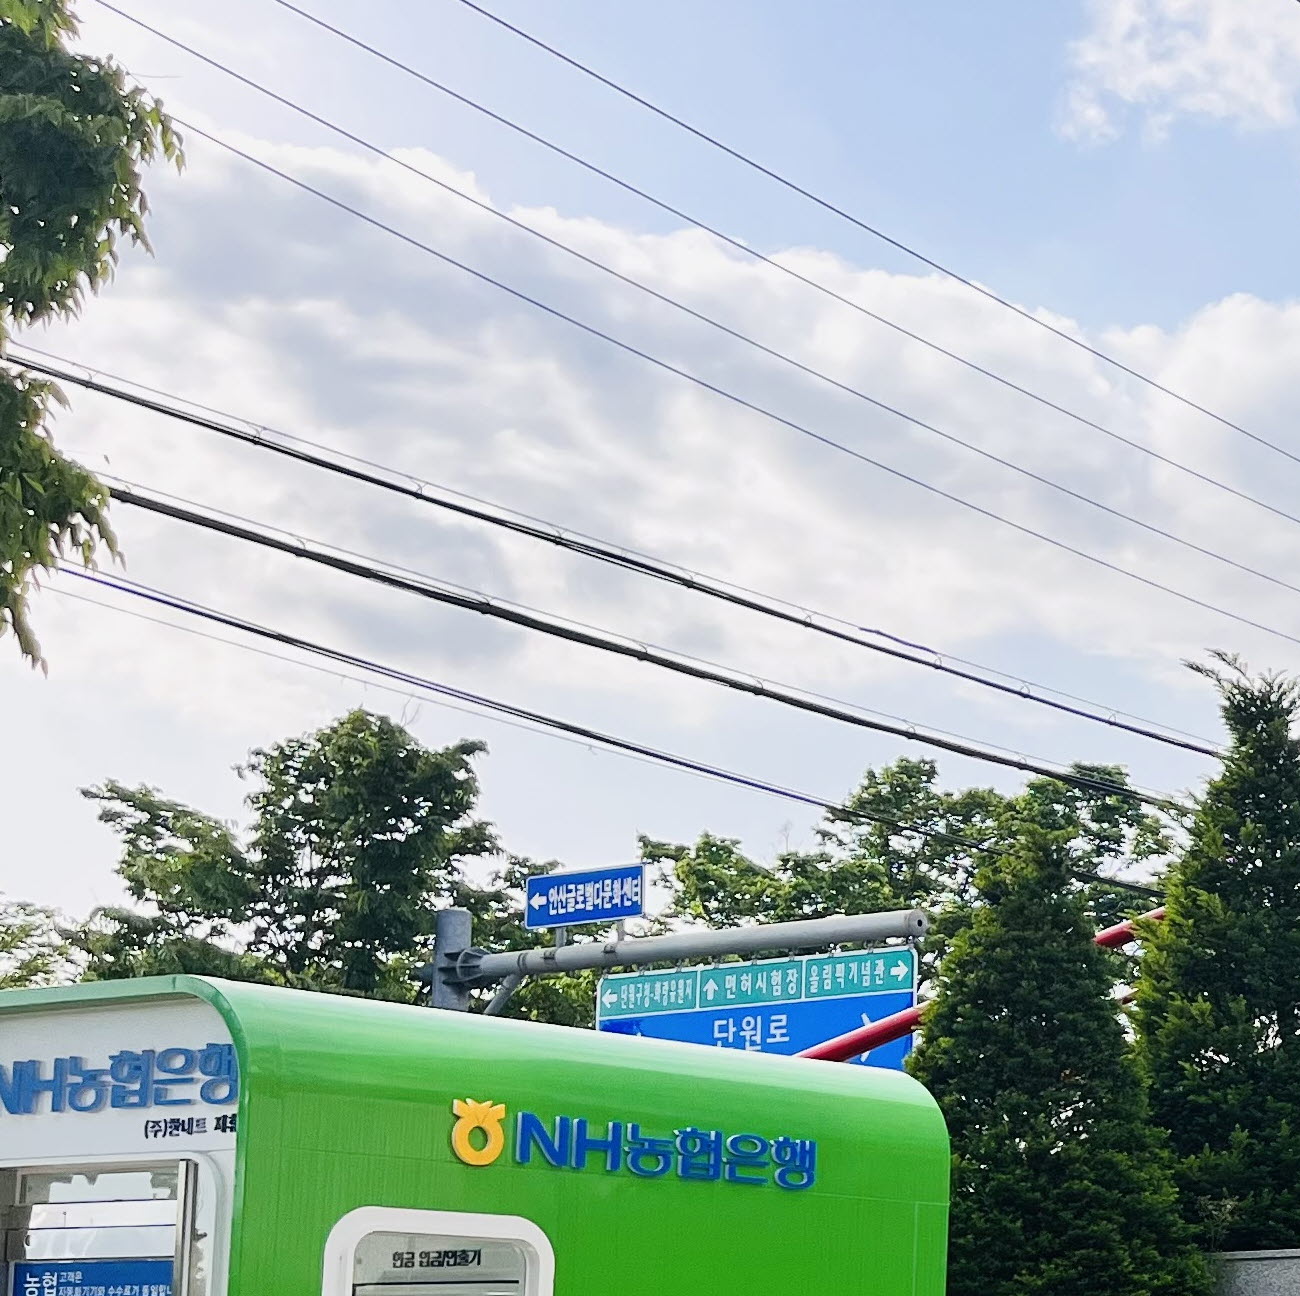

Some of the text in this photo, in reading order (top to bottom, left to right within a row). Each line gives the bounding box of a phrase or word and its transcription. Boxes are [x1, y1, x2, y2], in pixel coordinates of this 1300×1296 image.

[548, 875, 641, 916] 안산글로벌다문화센터
[724, 966, 799, 999] 면허시험장
[808, 958, 886, 992] 올림픽기념관
[713, 1014, 790, 1050] 단원로
[515, 1110, 817, 1191] NH농협은행
[59, 1271, 83, 1283] 고객은
